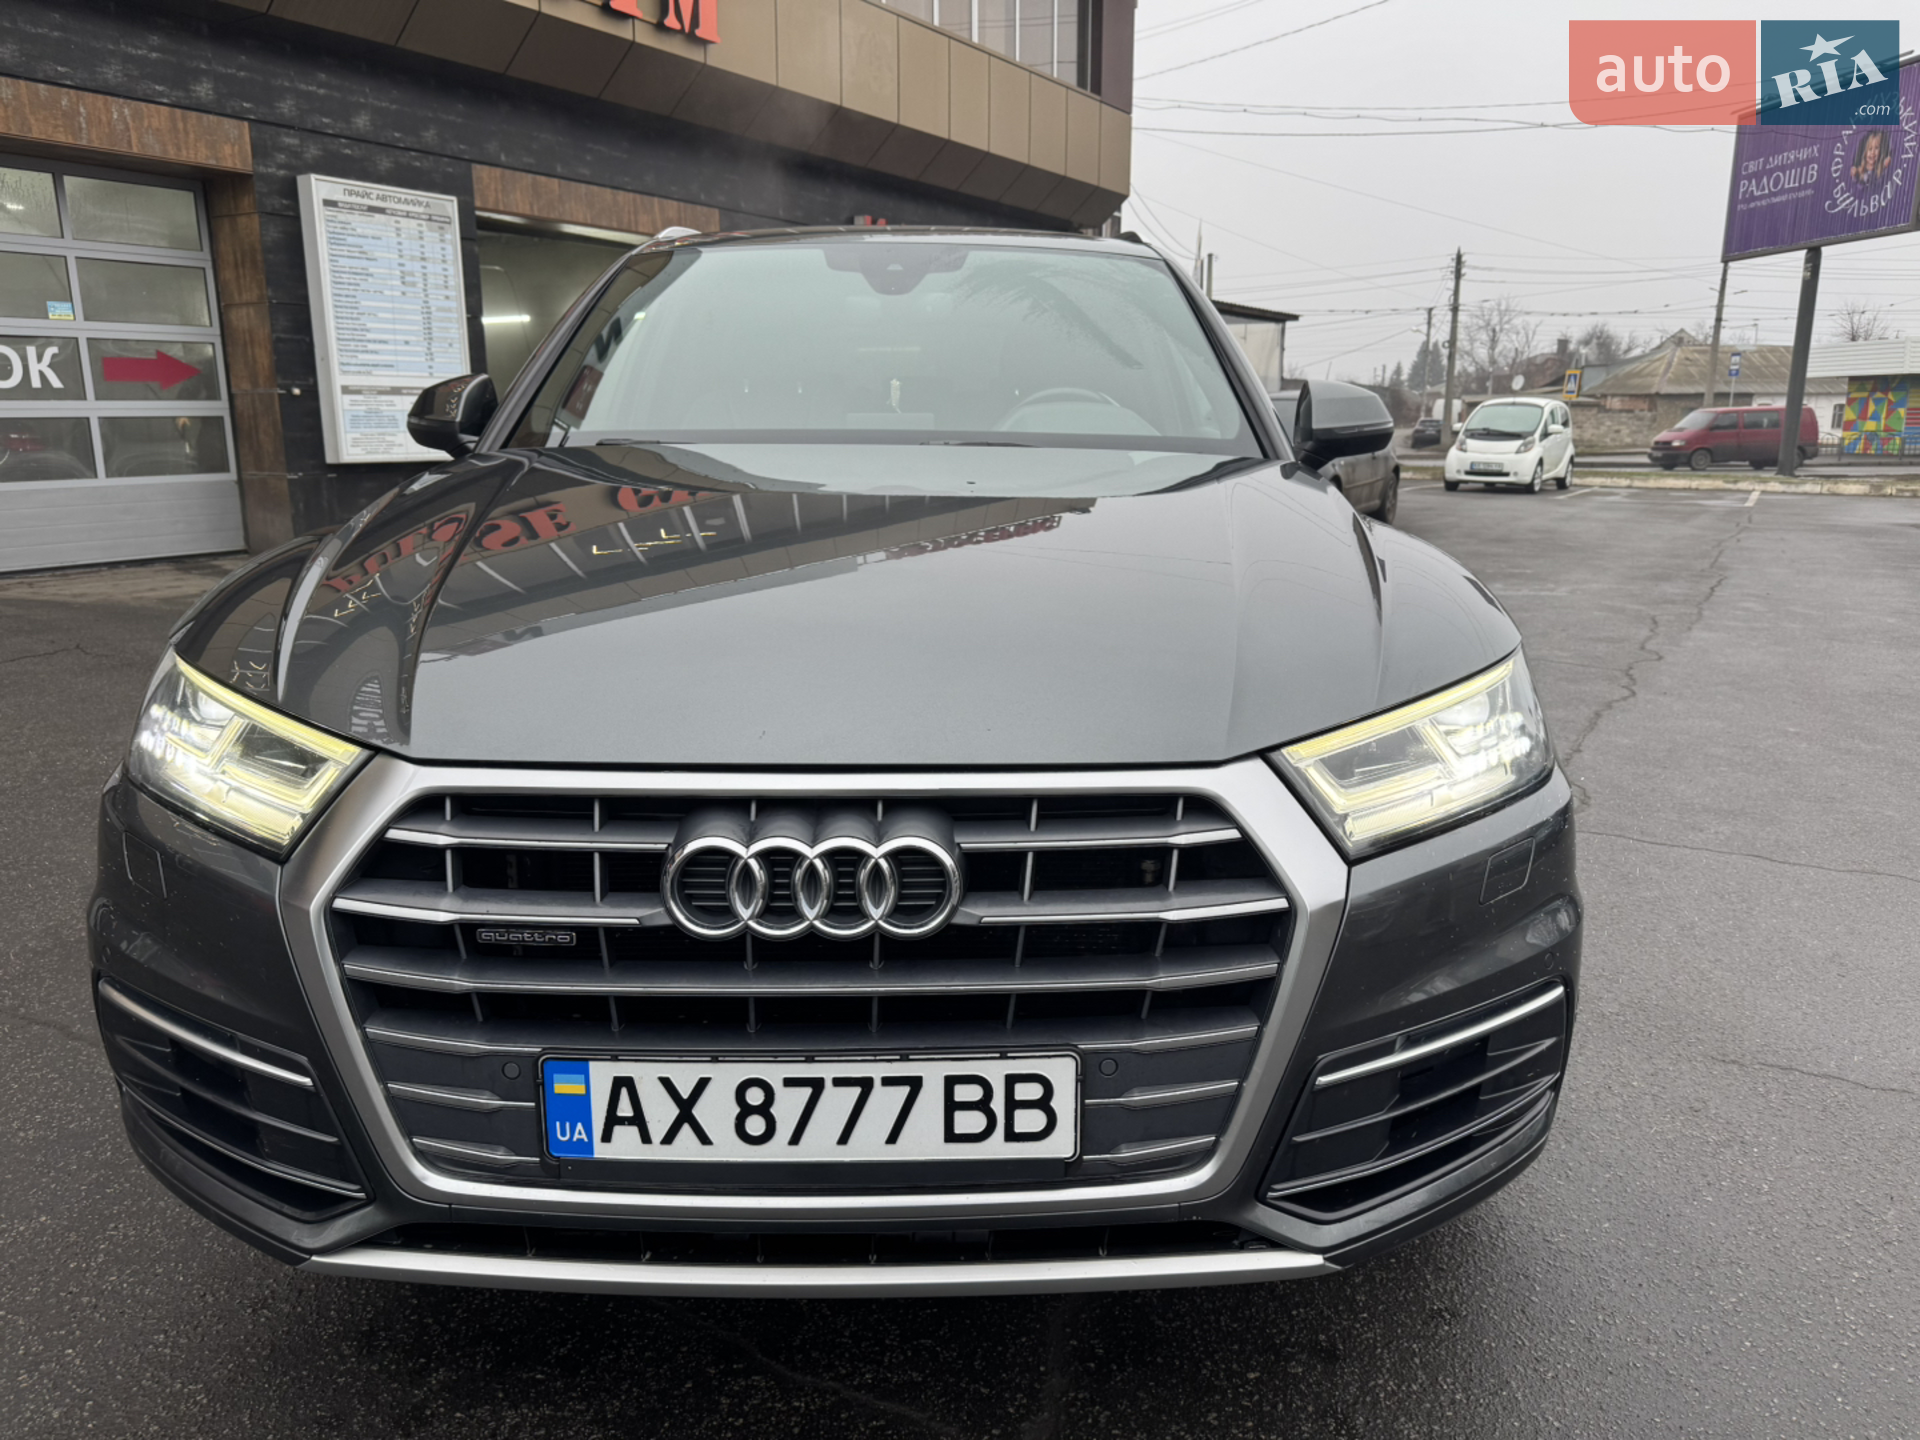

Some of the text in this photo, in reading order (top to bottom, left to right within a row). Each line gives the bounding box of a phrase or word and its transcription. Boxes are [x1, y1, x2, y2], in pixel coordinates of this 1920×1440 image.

[1741, 144, 1820, 175] СВІТ ДИТЯЧИХ
[1738, 163, 1818, 200] РАДОШІВ
[343, 187, 375, 201] ПРАЙС
[375, 192, 432, 209] АВТОМИЙКА
[481, 932, 571, 943] quattro
[556, 1072, 1058, 1146] UA AX 8777 BB
